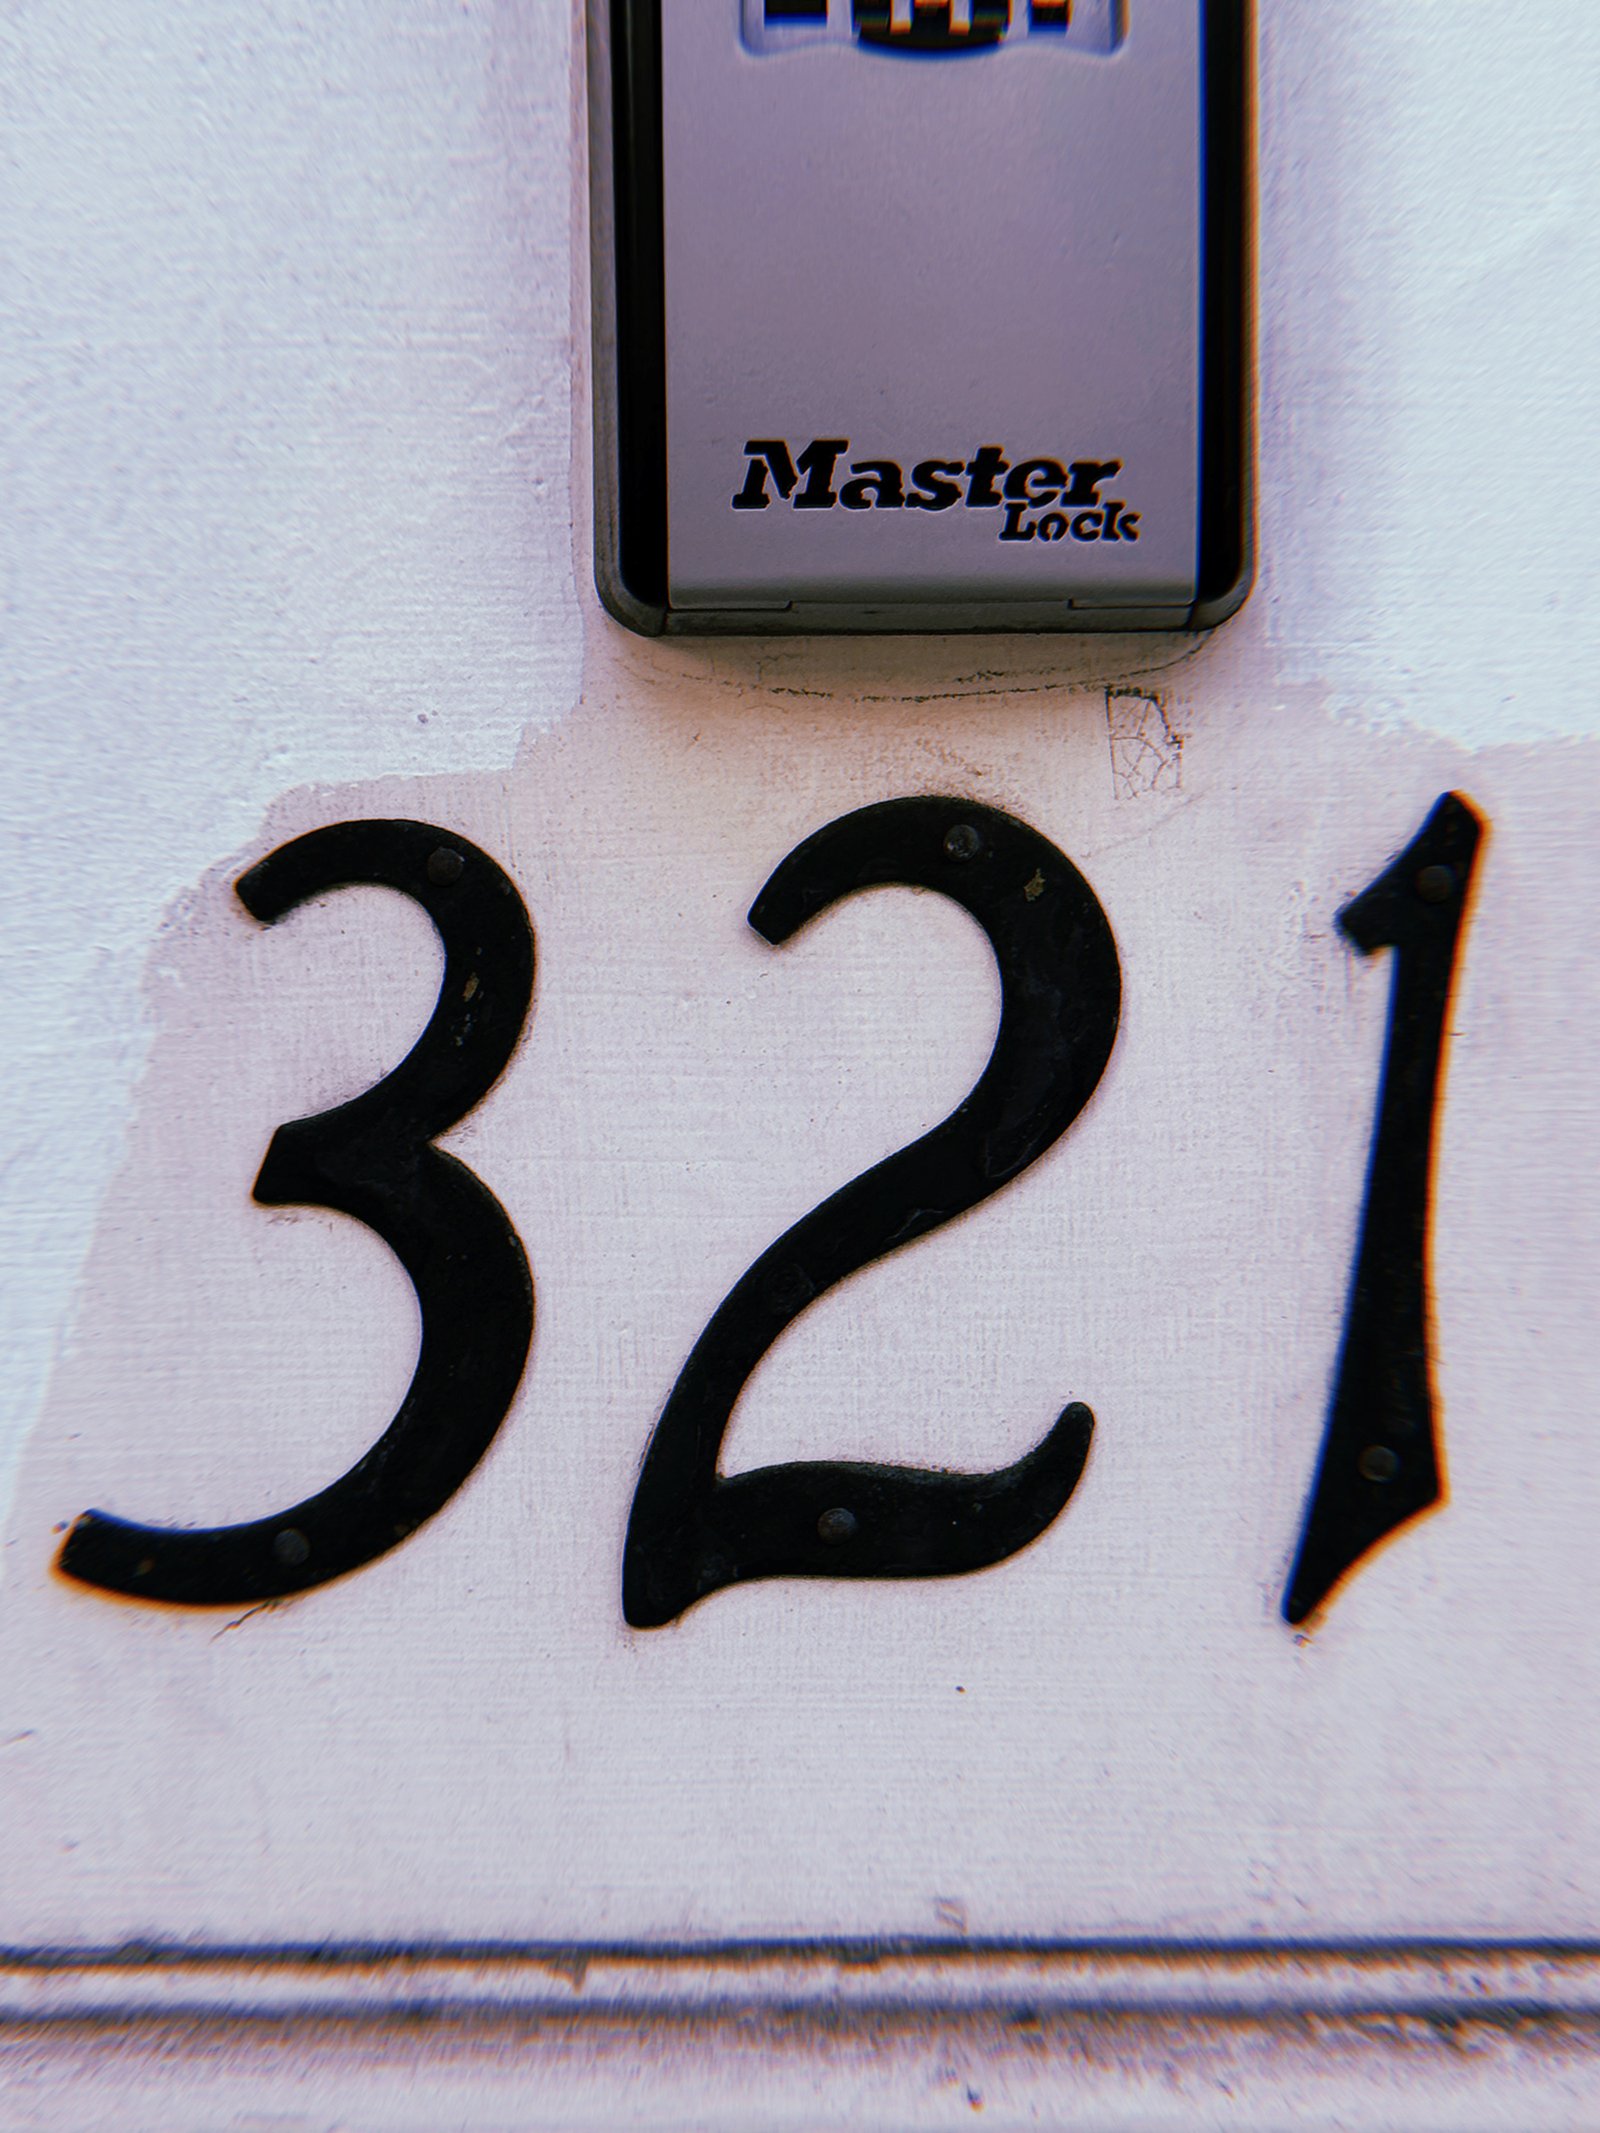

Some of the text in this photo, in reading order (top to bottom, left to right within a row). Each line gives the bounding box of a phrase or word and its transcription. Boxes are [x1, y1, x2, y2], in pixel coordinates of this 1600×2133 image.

[732, 438, 1121, 512] Master
[1000, 501, 1139, 542] Lock
[54, 790, 1492, 1630] 321
